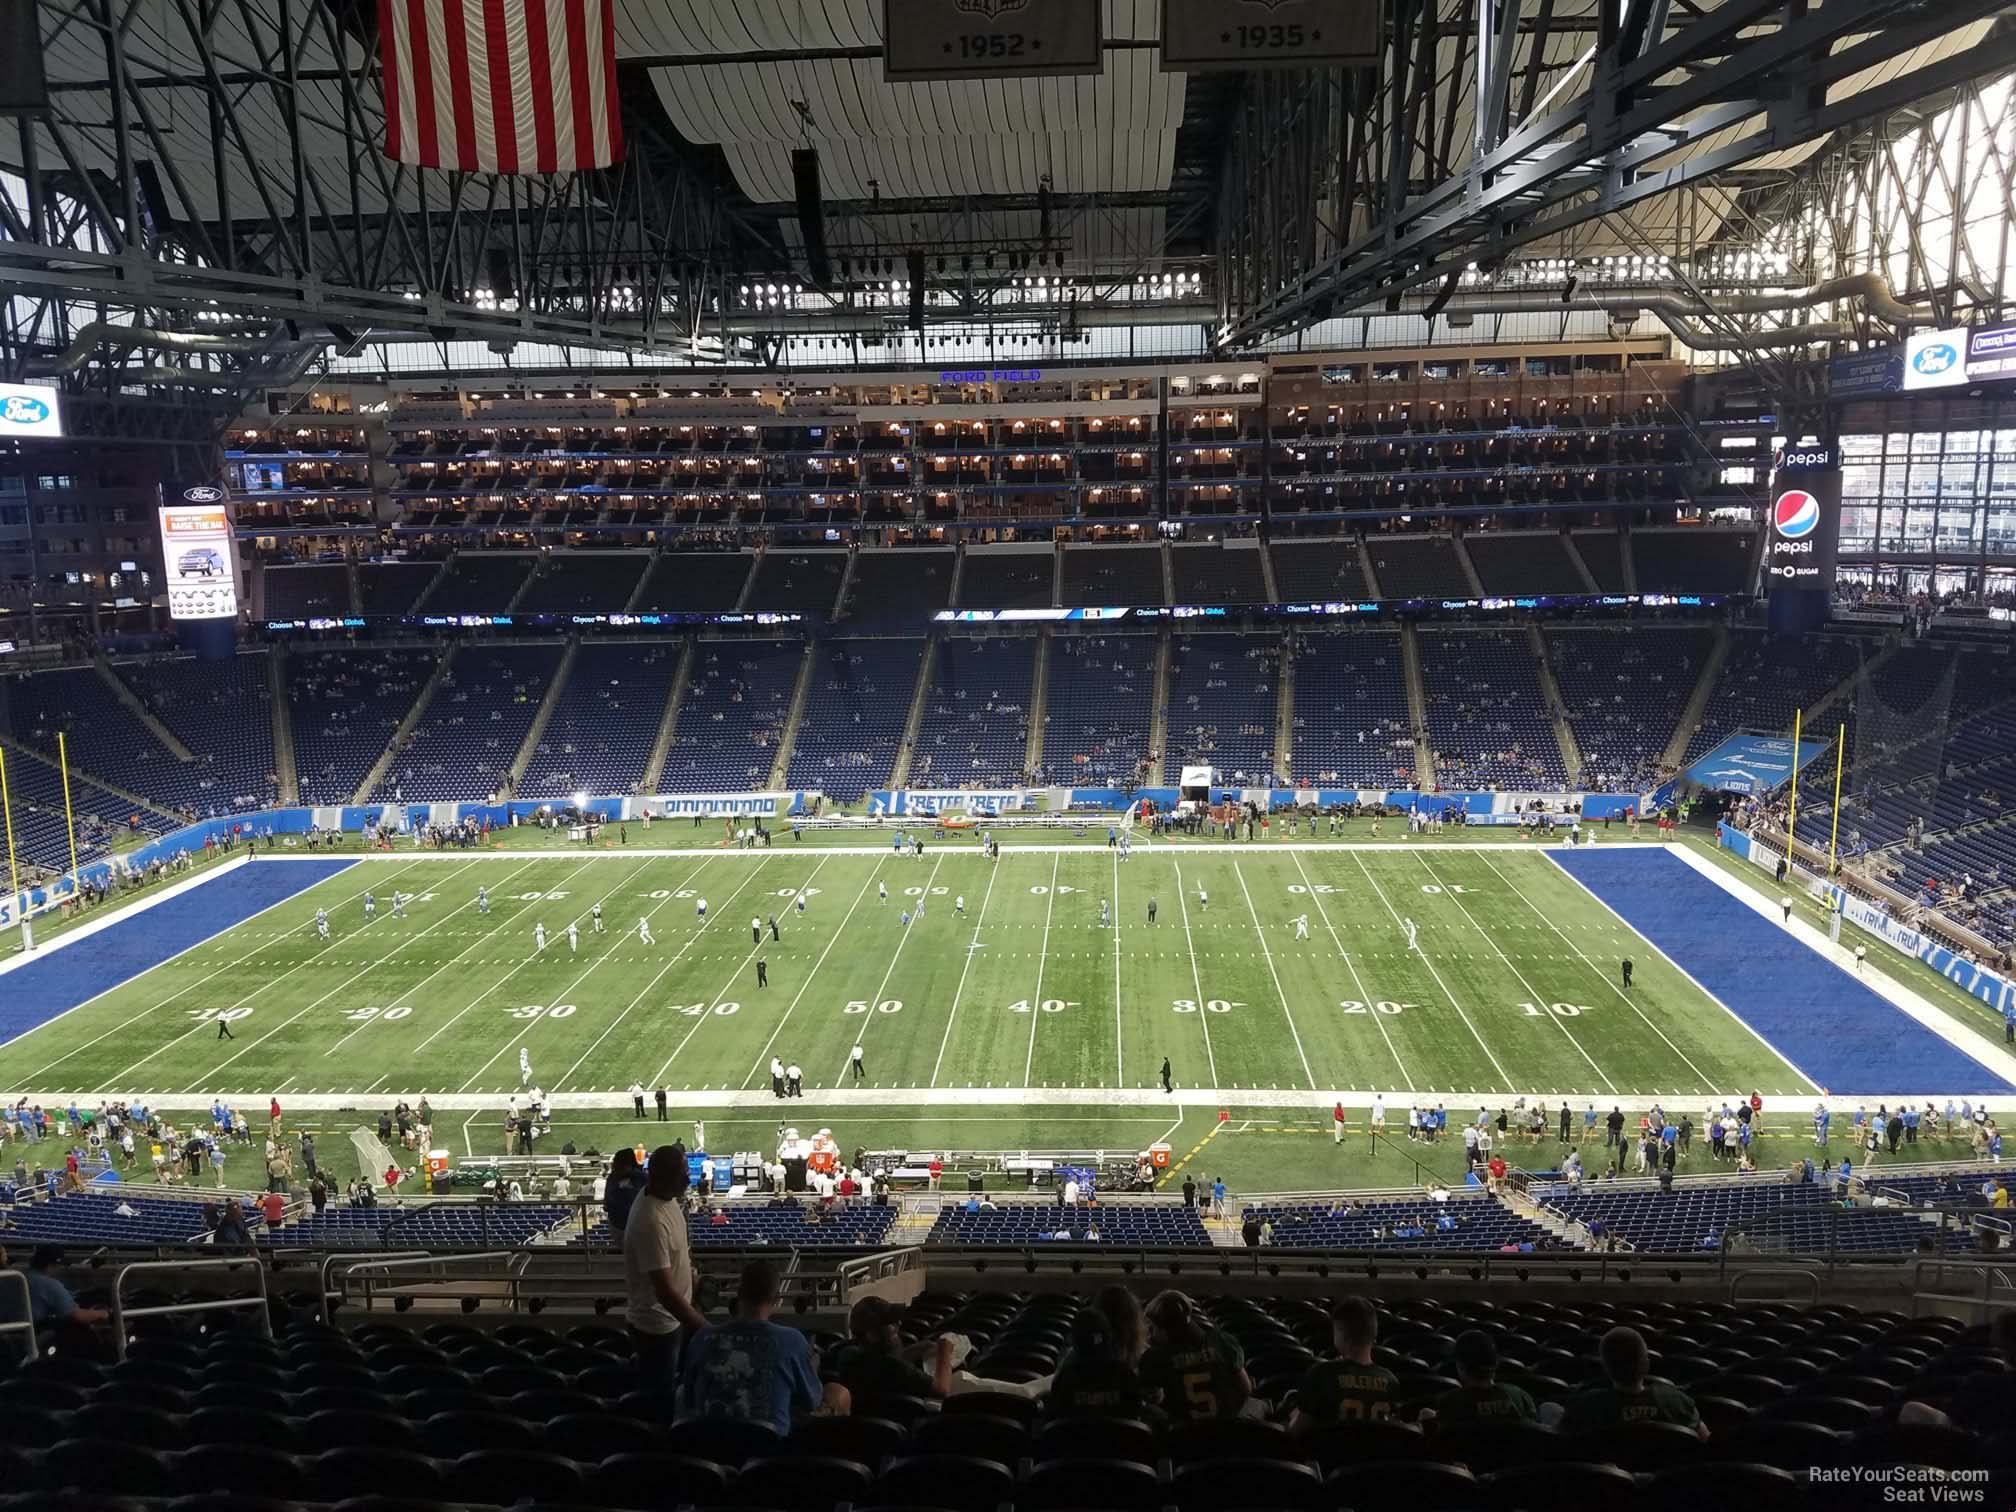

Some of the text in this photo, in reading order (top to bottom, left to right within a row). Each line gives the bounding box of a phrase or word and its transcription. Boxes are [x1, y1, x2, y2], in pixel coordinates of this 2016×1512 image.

[1238, 25, 1304, 48] 1935
[959, 34, 1025, 59] 1952
[942, 369, 1041, 382] FORD FIELD
[1786, 451, 1829, 466] pepsi
[1774, 540, 1813, 555] pepsi
[1724, 780, 1751, 793] LIONS
[347, 1006, 413, 1020] 20
[514, 1004, 577, 1018] 30
[679, 1002, 740, 1016] 40
[844, 1000, 903, 1014] 50
[1008, 1000, 1066, 1013] 40
[1172, 1000, 1232, 1013] 30
[1340, 1001, 1404, 1015] 20
[1517, 1002, 1581, 1017] 10
[1183, 1371, 1218, 1420] 5
